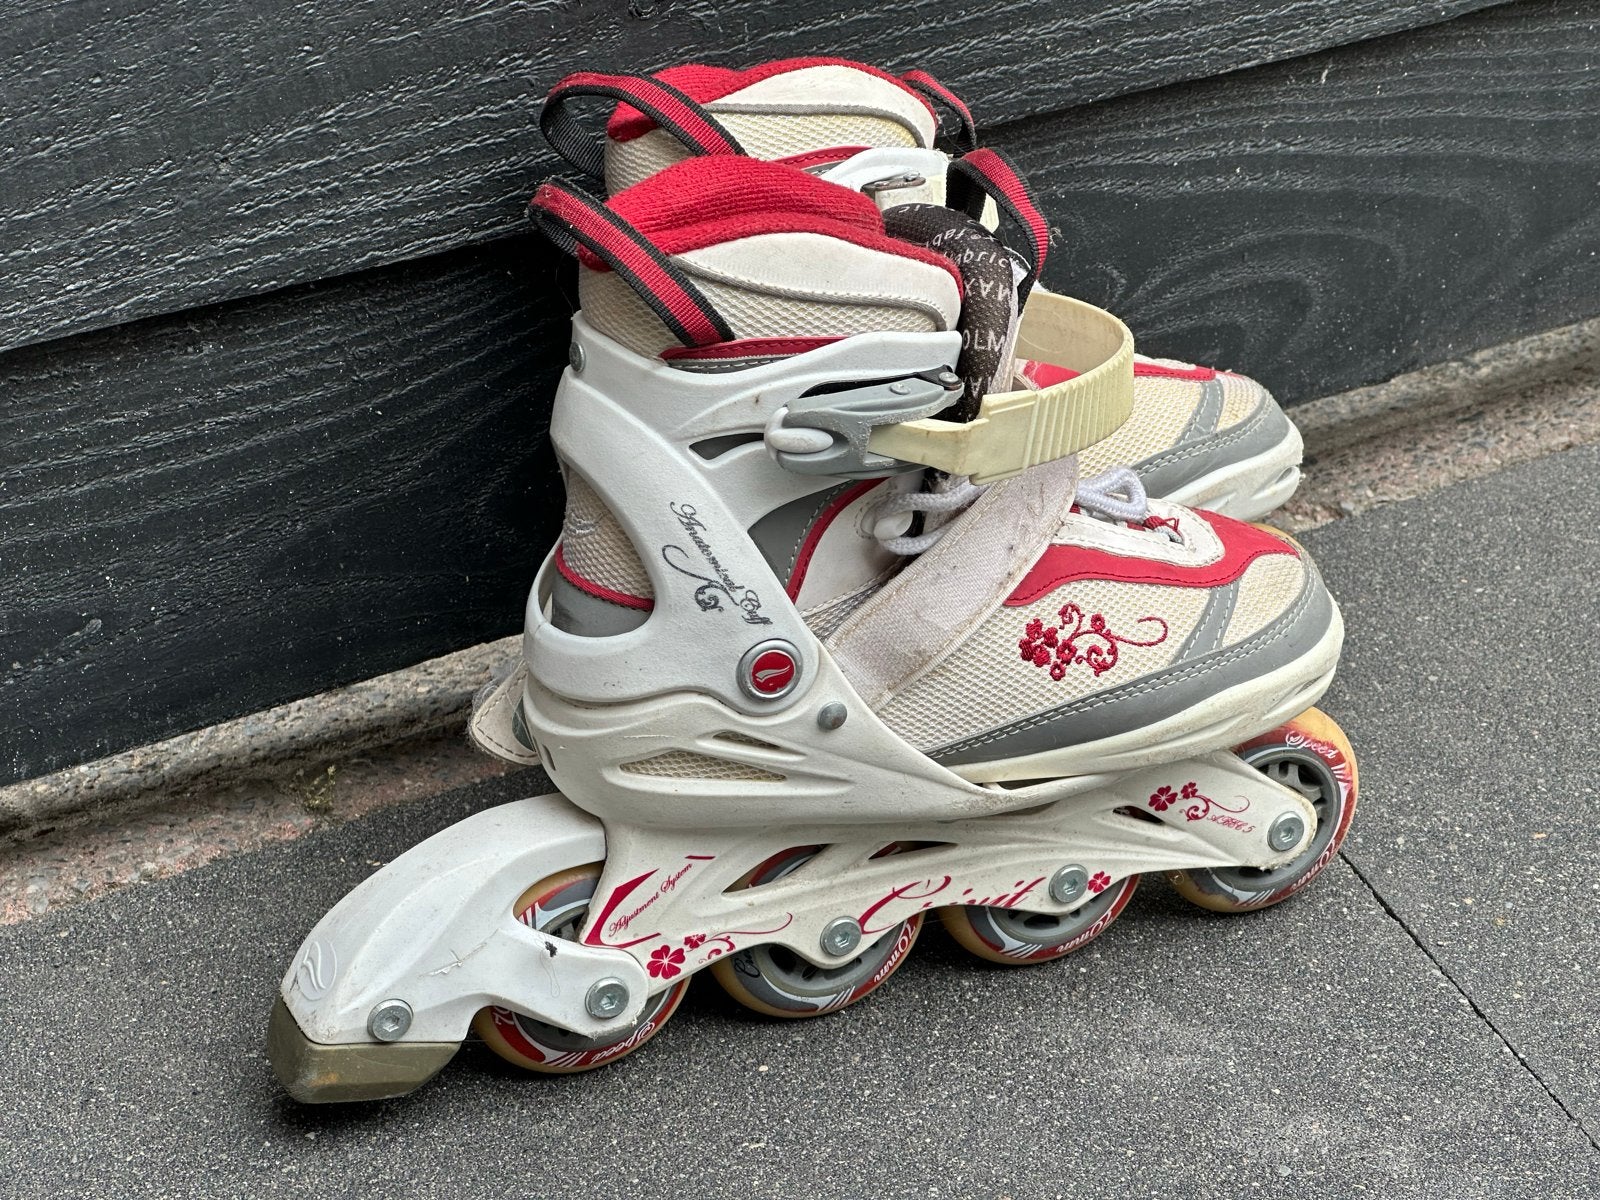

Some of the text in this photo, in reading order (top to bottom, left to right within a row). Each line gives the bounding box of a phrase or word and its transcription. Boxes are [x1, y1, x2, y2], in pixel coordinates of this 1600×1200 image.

[670, 501, 773, 624] Anatomical Cuff
[1285, 730, 1336, 759] Speed
[608, 863, 693, 937] Adjustment System
[873, 924, 916, 982] 70mm
[1056, 910, 1114, 953] 70mm
[590, 1022, 655, 1064] Speed
